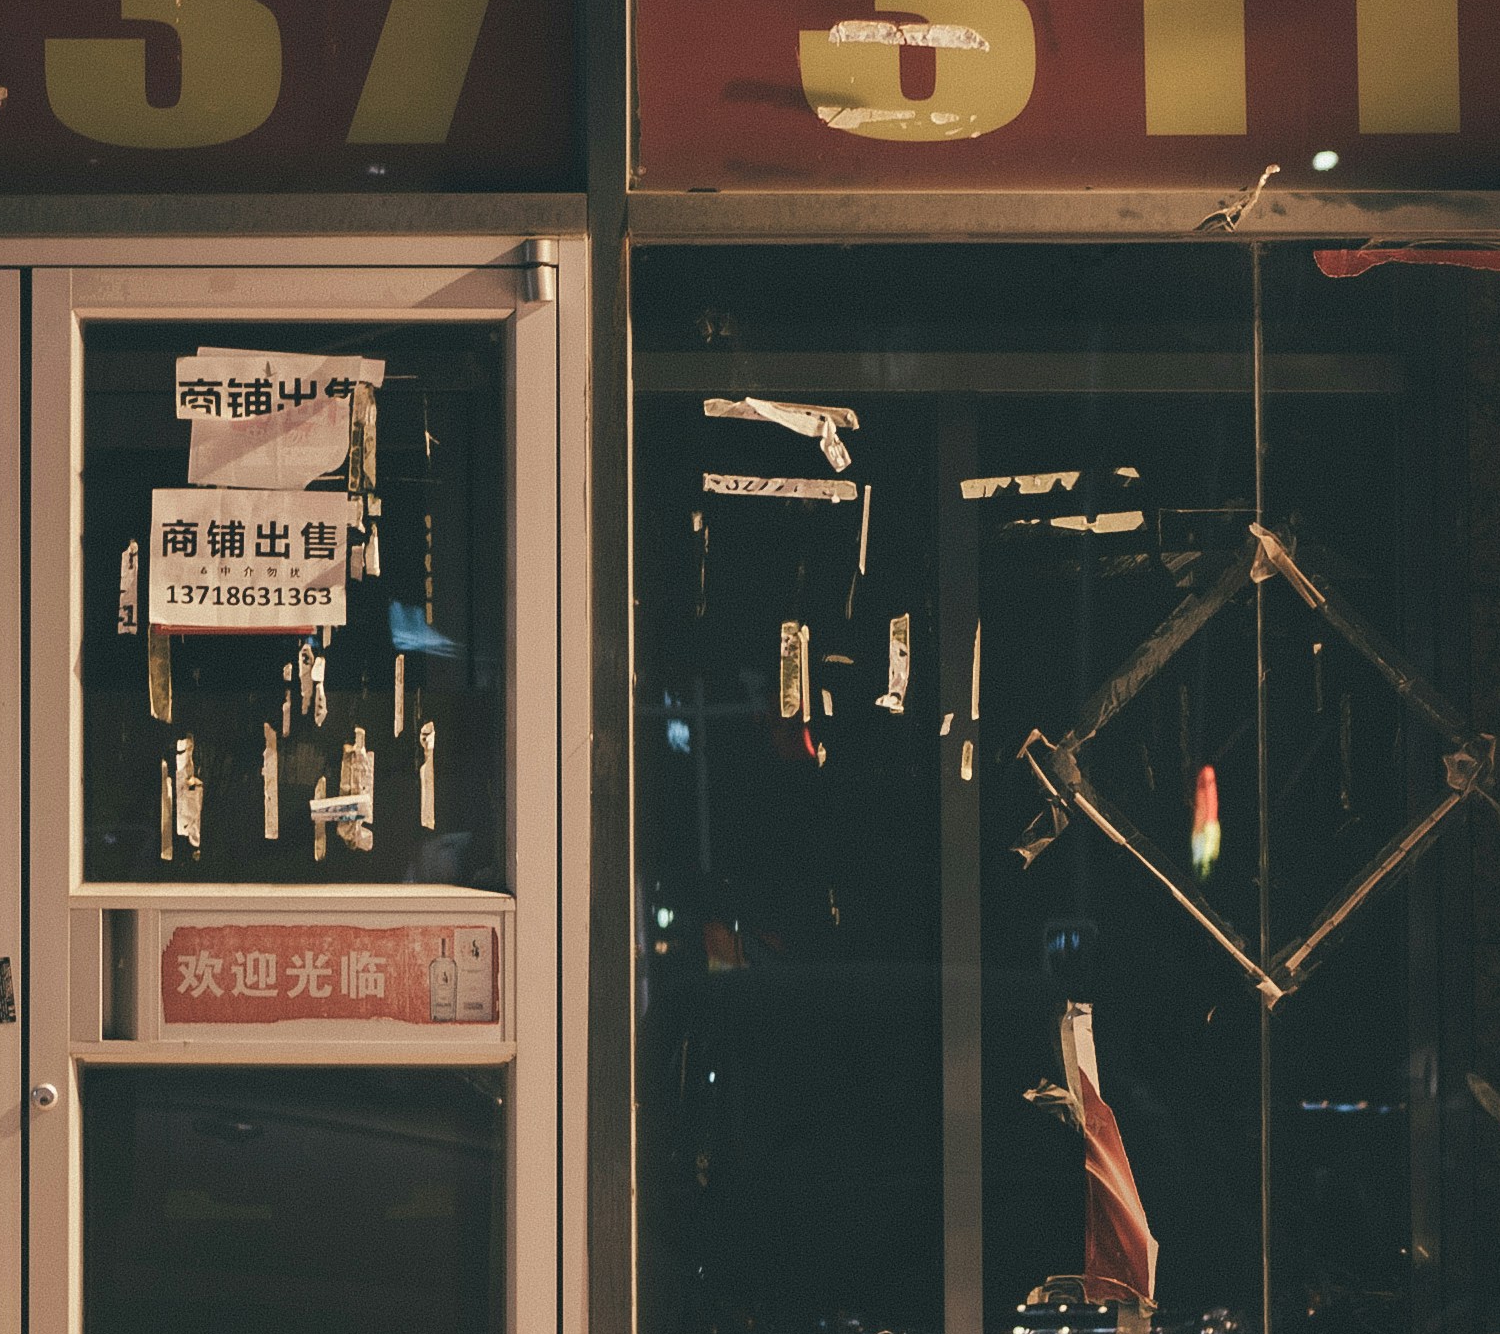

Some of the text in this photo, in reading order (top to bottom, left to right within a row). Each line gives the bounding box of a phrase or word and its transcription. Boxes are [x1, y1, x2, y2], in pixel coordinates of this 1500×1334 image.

[162, 519, 338, 560] 商铺出售
[165, 584, 333, 607] 13718631363
[176, 950, 388, 1000] 欢迎光临
